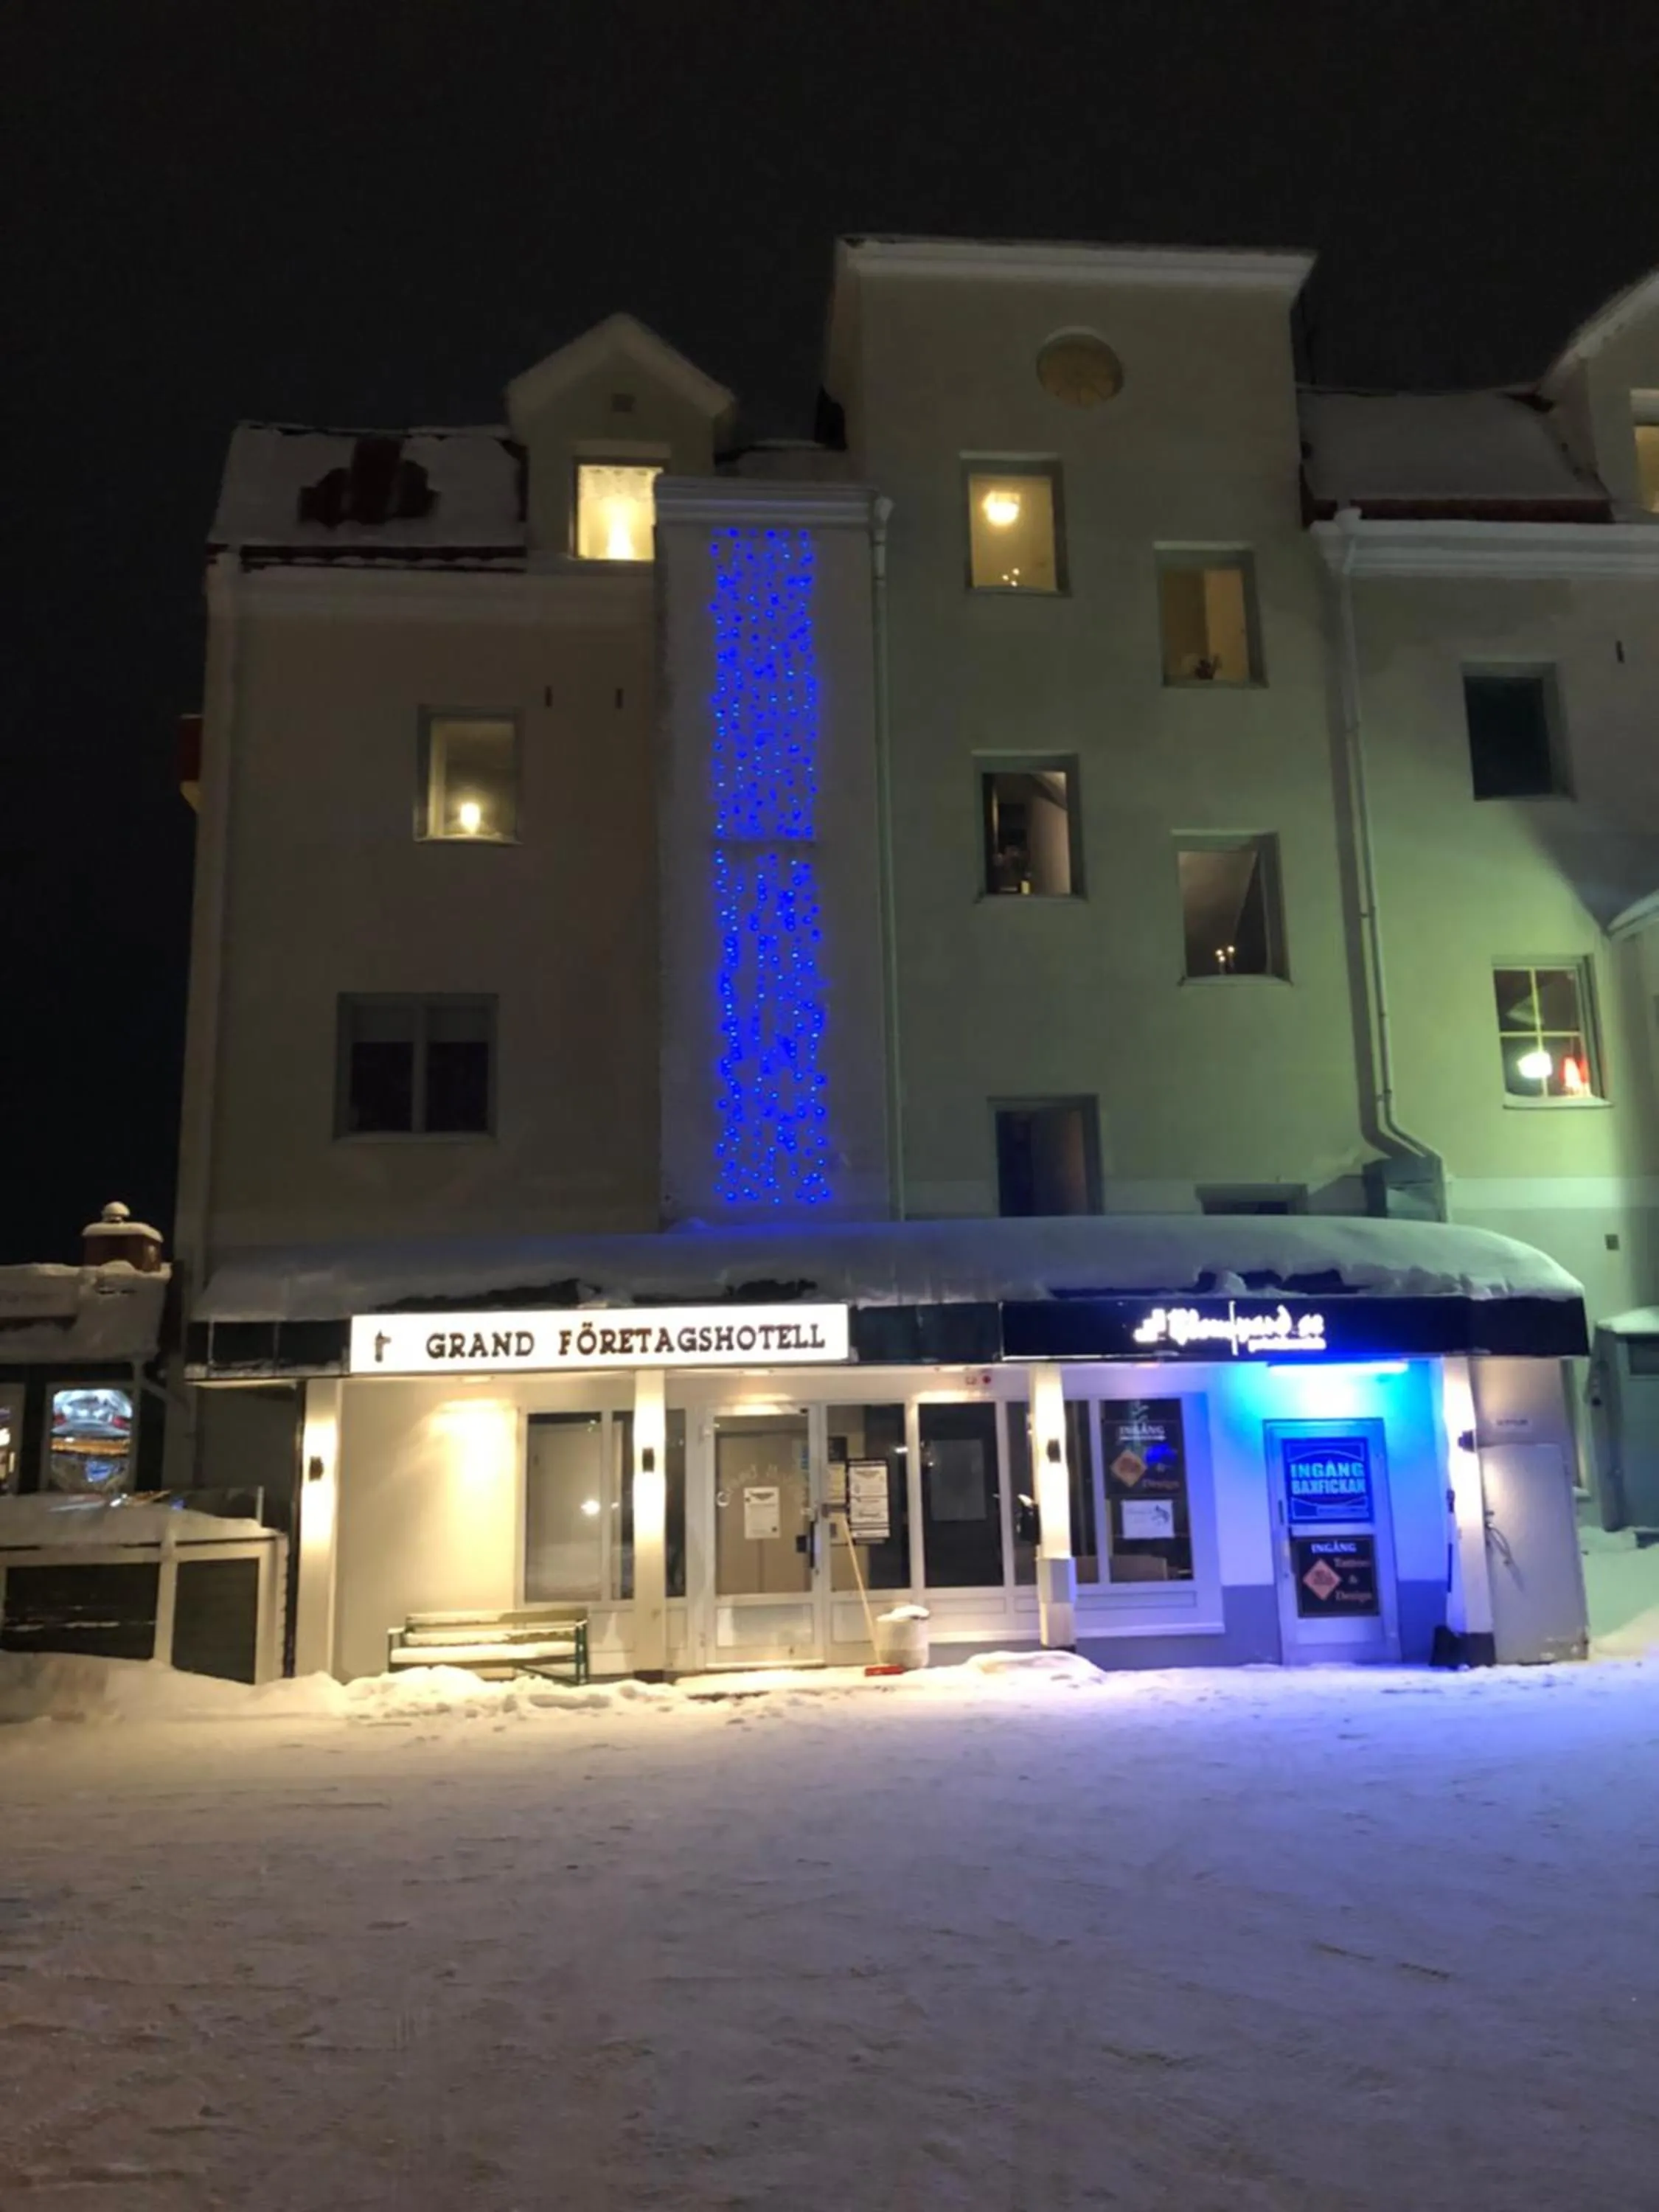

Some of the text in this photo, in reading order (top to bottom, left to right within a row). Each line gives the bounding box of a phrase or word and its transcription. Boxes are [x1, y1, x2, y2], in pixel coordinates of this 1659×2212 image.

[425, 1322, 825, 1360] GRAND FÖRETAGSHOTELL
[1119, 1422, 1165, 1435] INGÅNG
[1290, 1458, 1364, 1478] INGÅNG
[1311, 1539, 1357, 1554] INGÅNG
